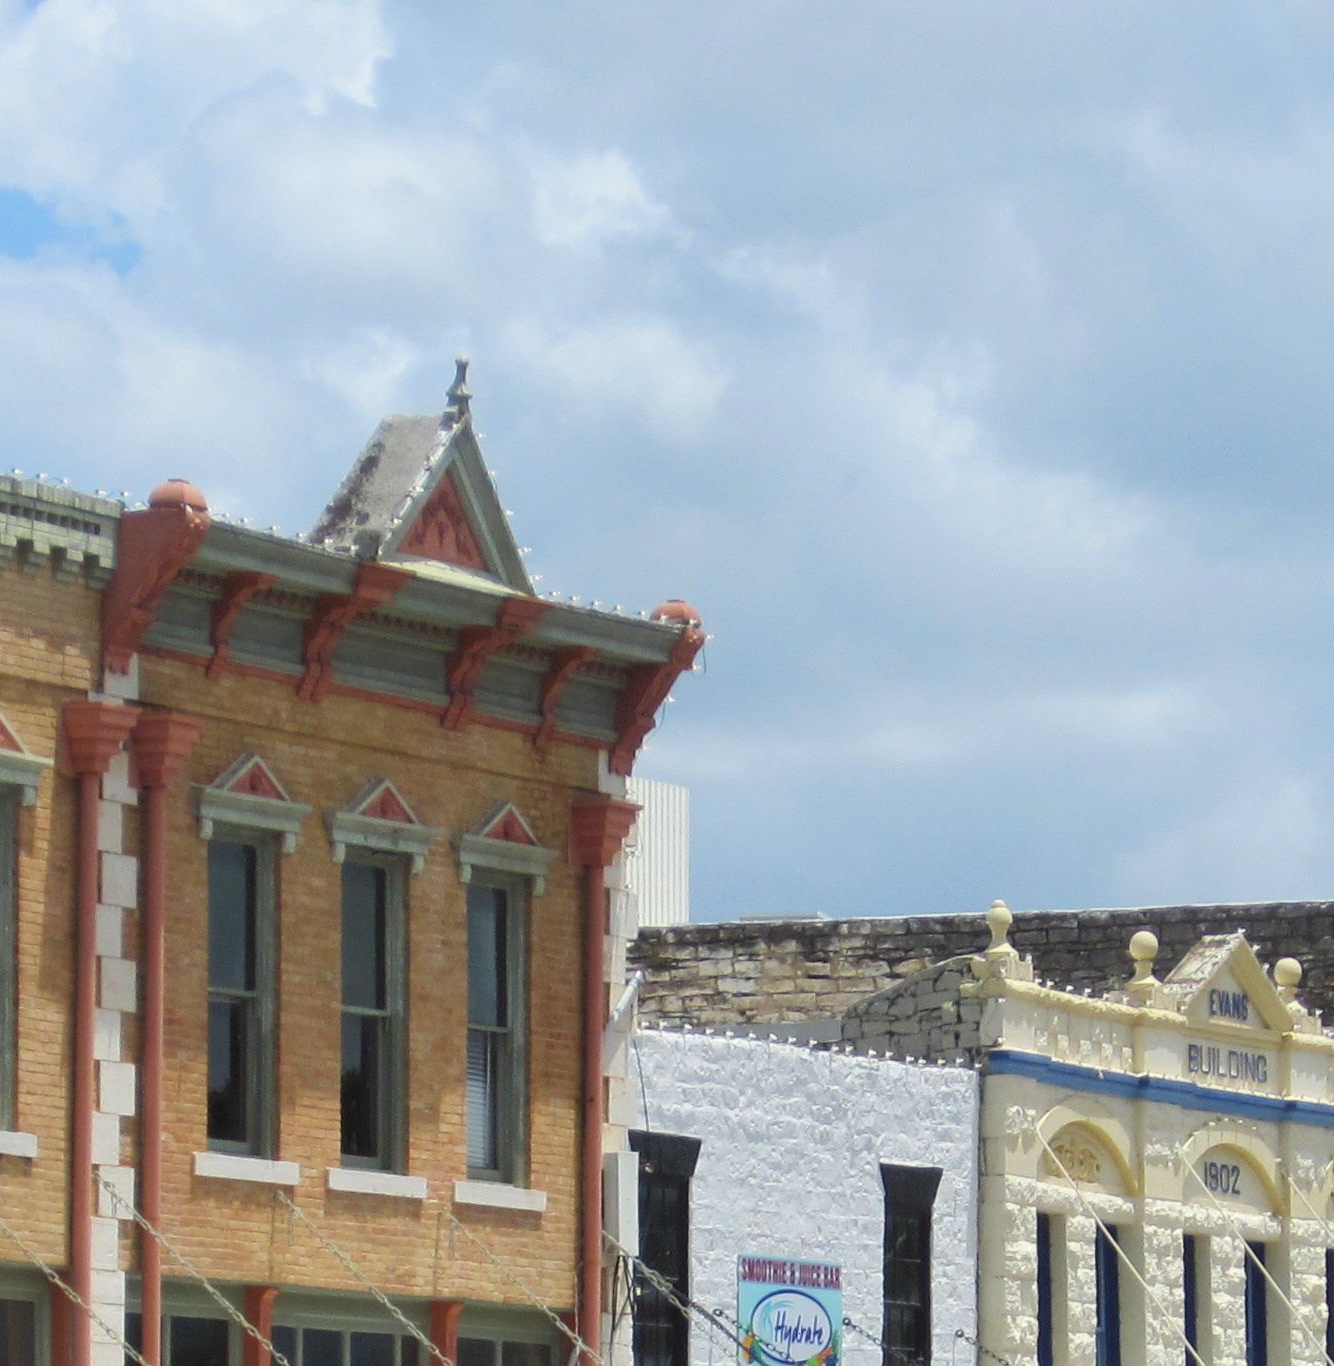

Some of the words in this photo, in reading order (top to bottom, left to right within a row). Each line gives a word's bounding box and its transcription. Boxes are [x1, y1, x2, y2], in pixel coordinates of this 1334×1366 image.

[1209, 988, 1249, 1021] EVANS
[1188, 1044, 1268, 1083] BUILDING
[1204, 1161, 1241, 1195] 1902
[741, 1258, 787, 1284] SMOOTHIE
[799, 1264, 821, 1287] JUICE
[824, 1266, 841, 1289] BAR
[774, 1310, 824, 1359] Hydrate
